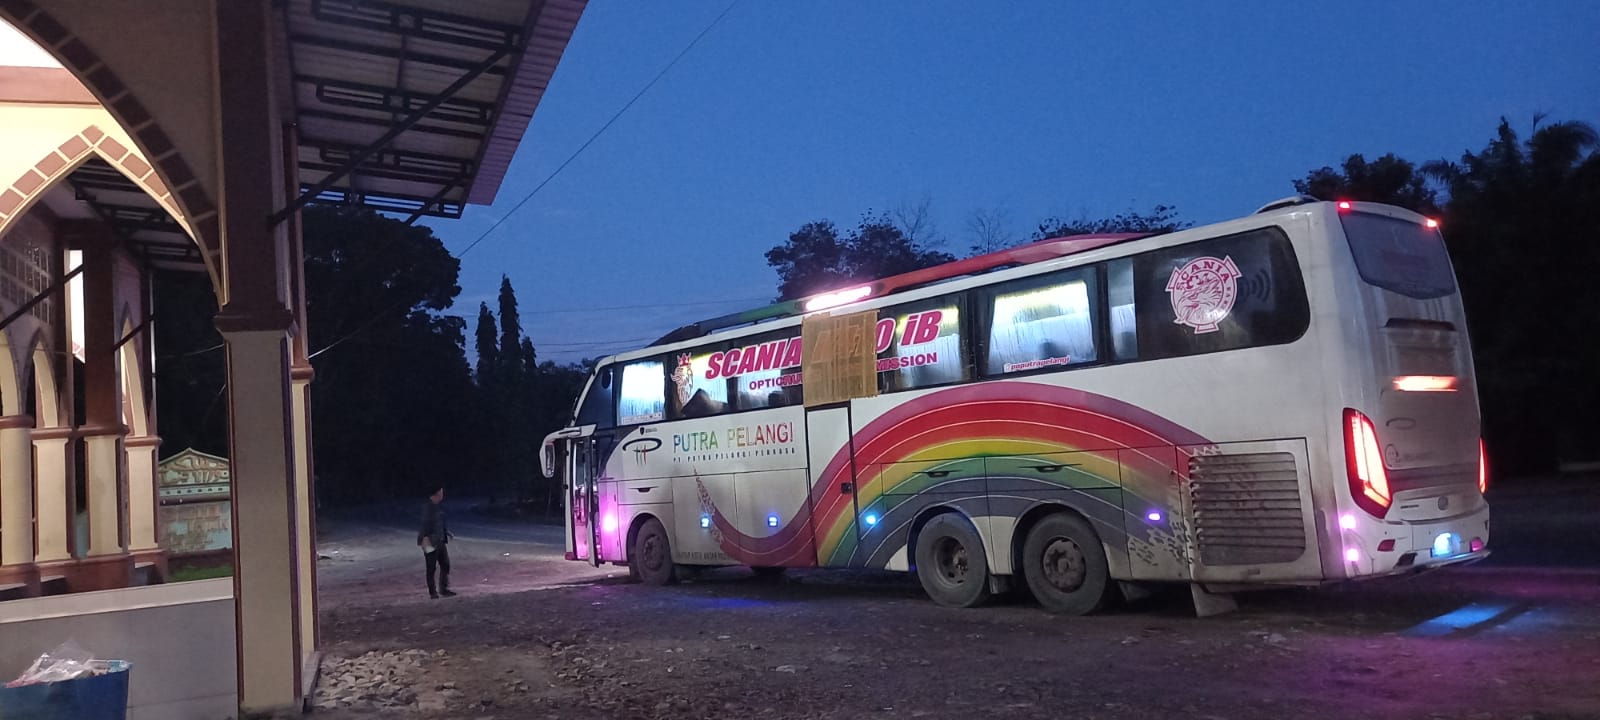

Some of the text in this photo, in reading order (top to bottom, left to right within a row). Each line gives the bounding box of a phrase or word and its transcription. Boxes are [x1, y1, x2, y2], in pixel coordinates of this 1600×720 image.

[1176, 261, 1230, 291] SCANIA
[706, 337, 802, 380] SCANIA
[900, 310, 943, 347] iB
[673, 422, 793, 454] PUTRA PELANGI
